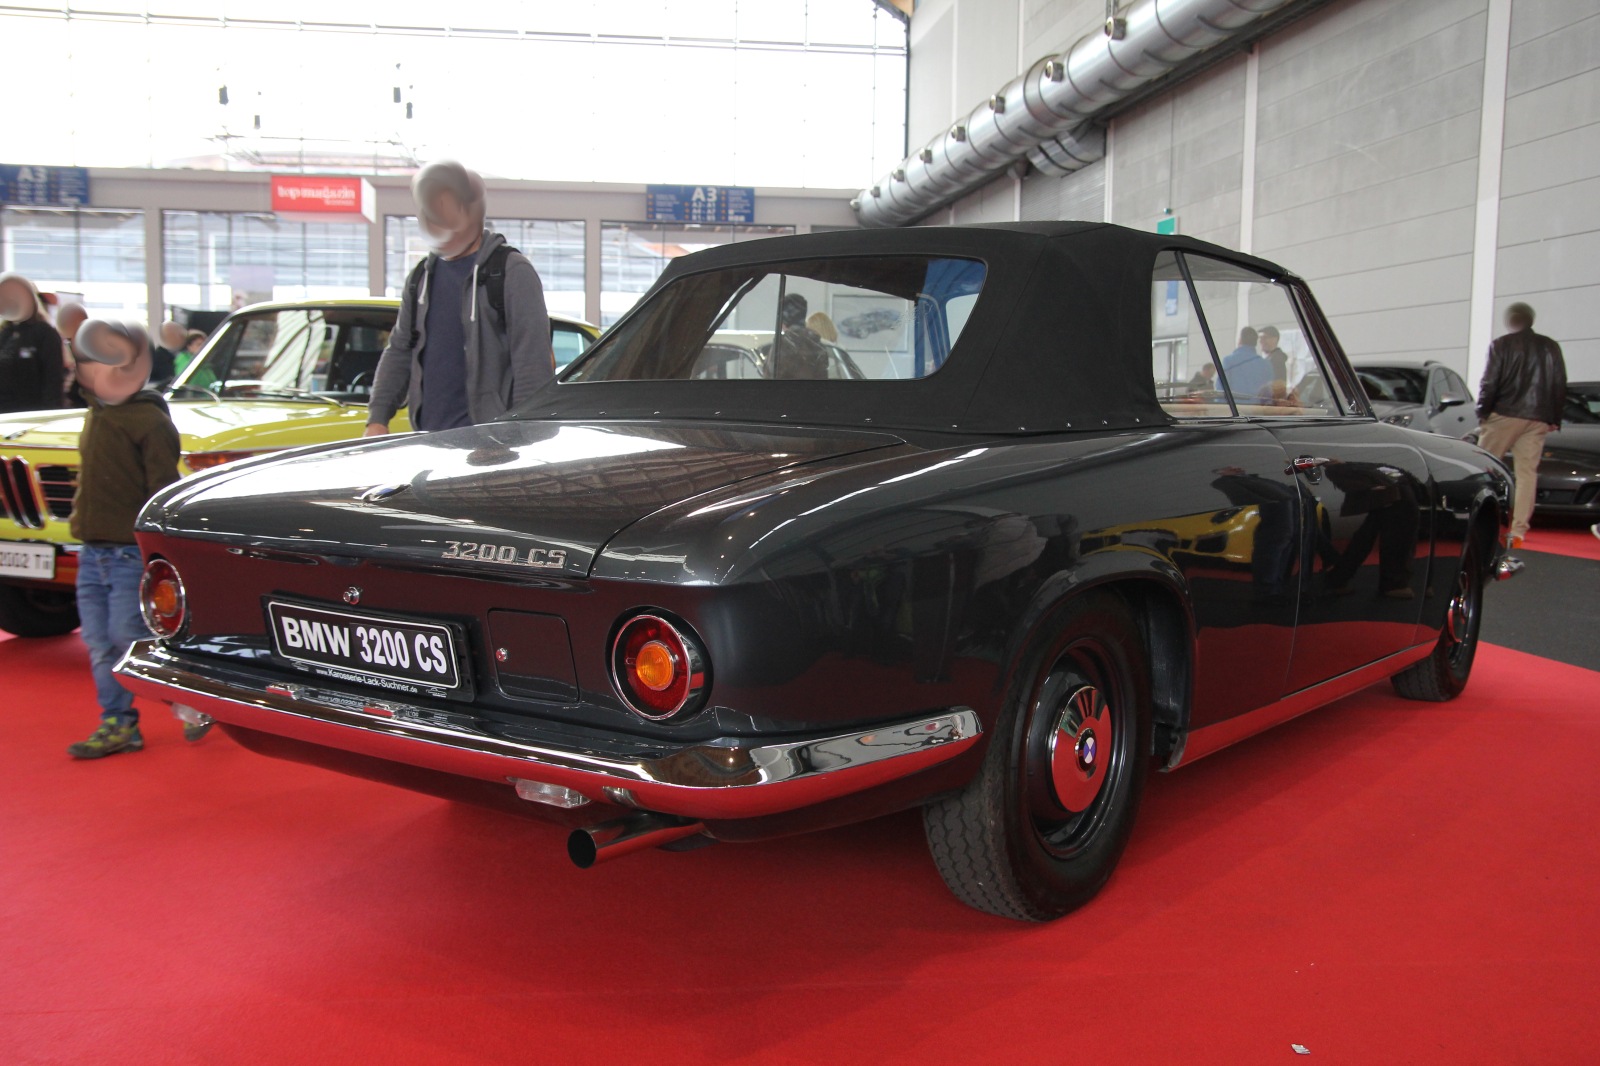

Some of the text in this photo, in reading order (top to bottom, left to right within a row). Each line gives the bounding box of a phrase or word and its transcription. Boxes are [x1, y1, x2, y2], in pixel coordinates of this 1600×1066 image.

[691, 187, 718, 202] A3
[442, 541, 567, 569] 3200 CS
[281, 616, 447, 674] BMW 3200 CS
[315, 668, 418, 693] www.Karosserie-Lack-Suchner.de
